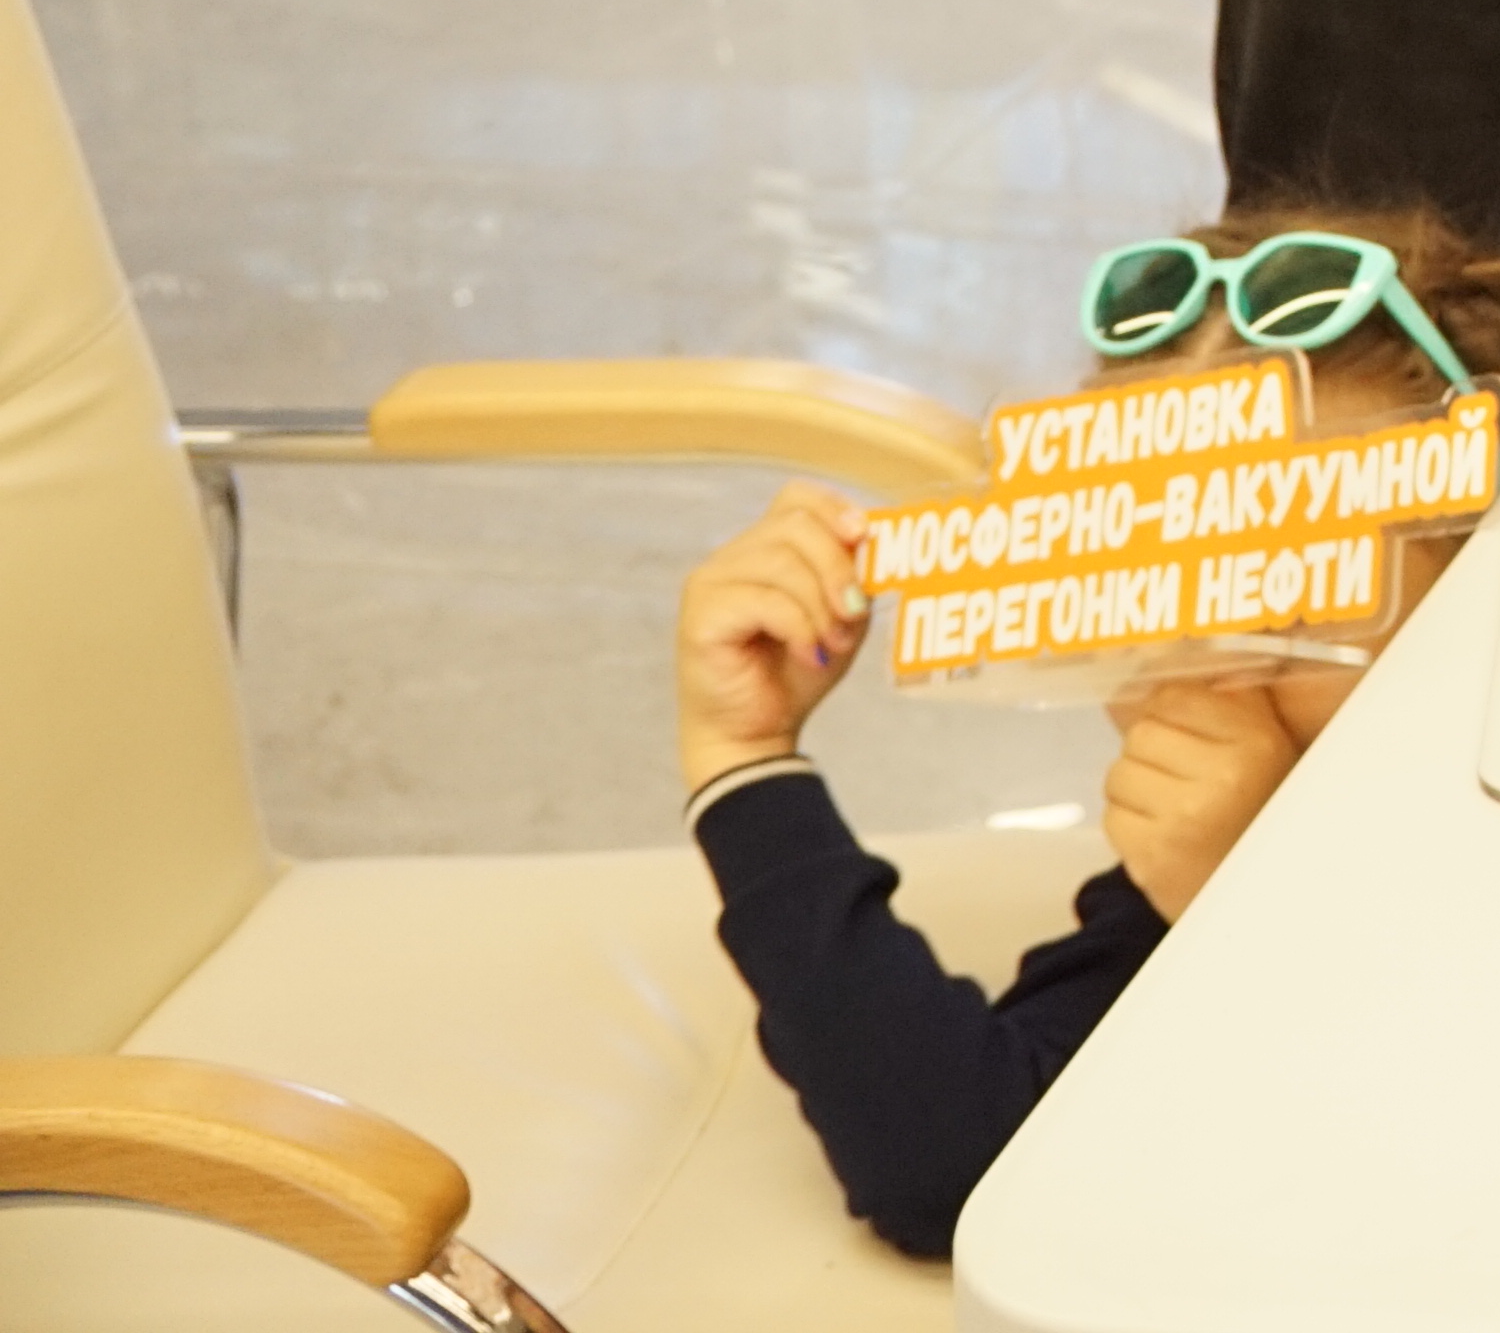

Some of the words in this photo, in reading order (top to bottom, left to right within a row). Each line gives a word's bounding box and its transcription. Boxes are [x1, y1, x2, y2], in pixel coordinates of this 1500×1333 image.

[995, 371, 1286, 480] УСТАНОВКА
[860, 407, 1490, 583] МОСФЕРНО-ВАКУУМНОЙ
[900, 557, 1182, 665] ПЕРЕГОНКИ
[1194, 535, 1376, 625] НЕФТИ
